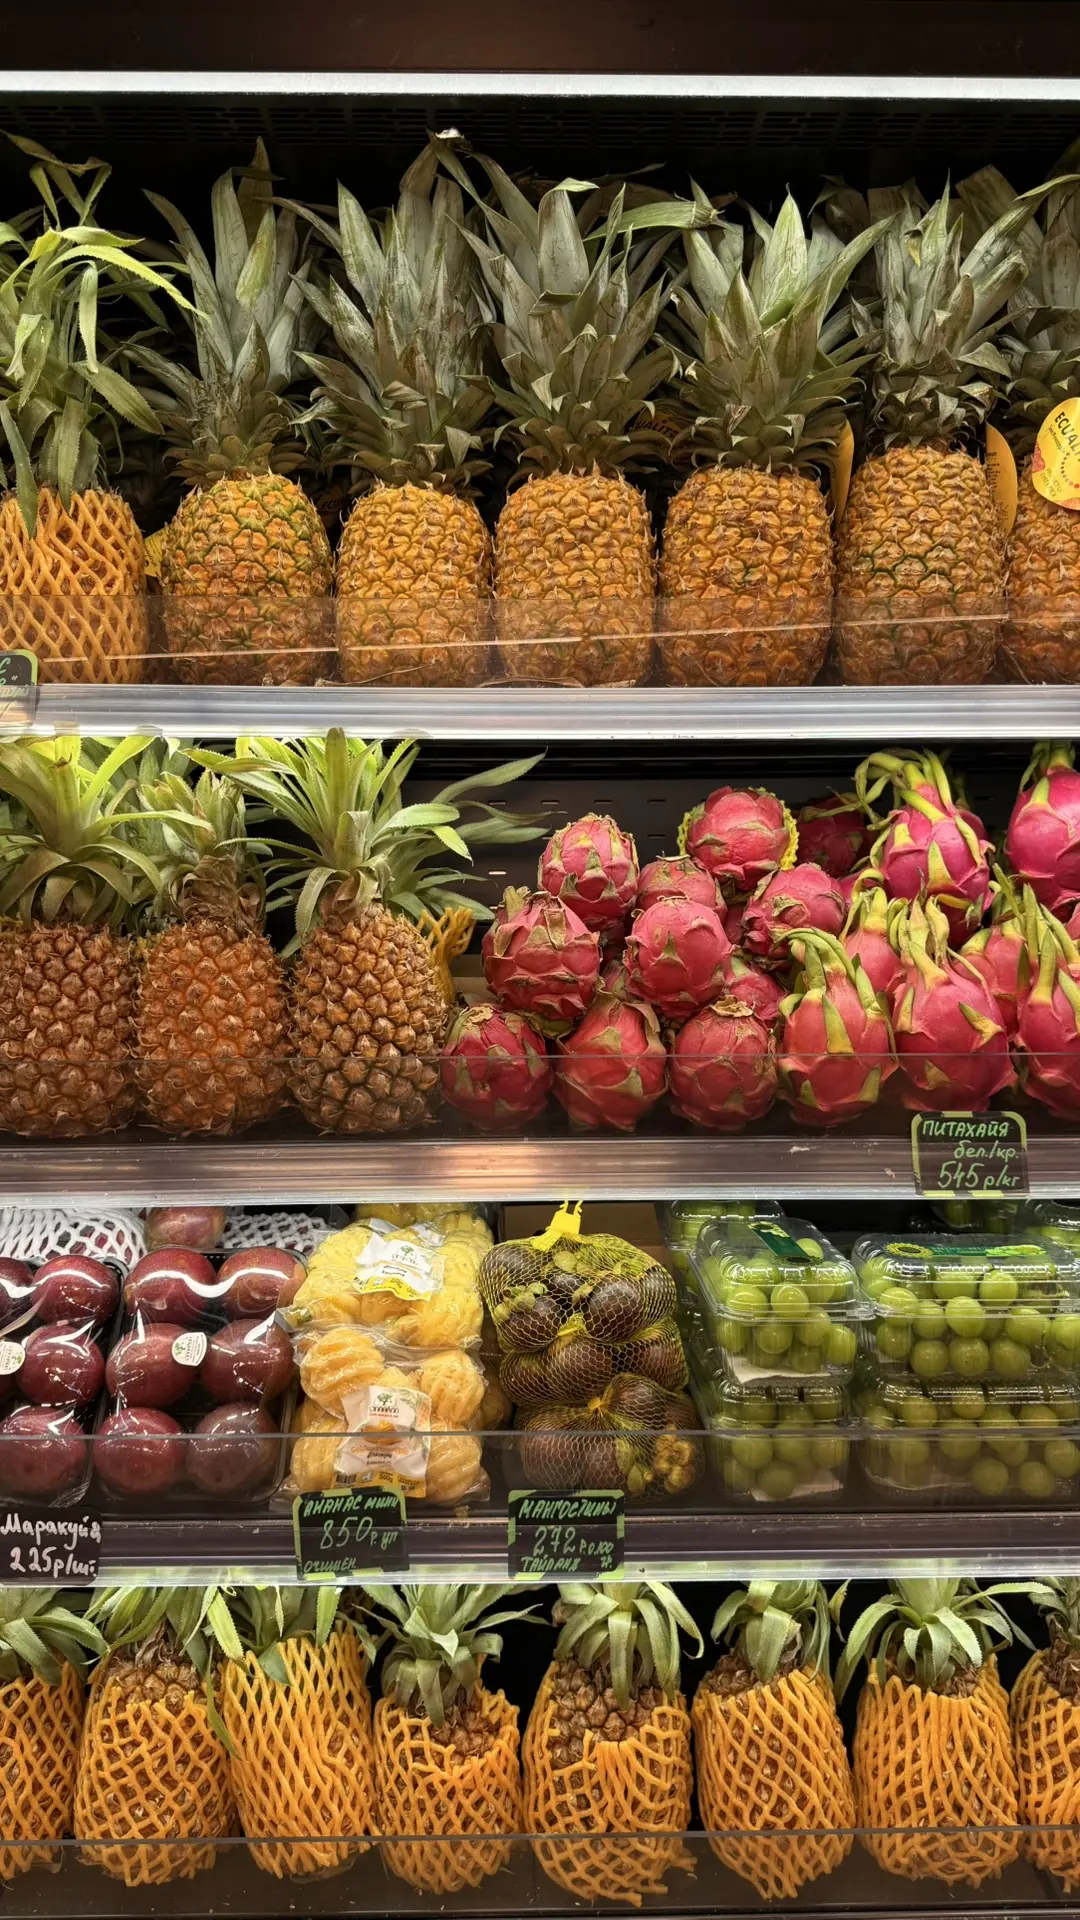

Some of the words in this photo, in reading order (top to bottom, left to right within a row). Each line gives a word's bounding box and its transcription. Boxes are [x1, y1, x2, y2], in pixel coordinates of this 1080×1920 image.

[922, 1120, 1010, 1138] ПИТАХАЙЯ
[937, 1161, 985, 1188] 545
[303, 1495, 363, 1517] АНАНАС
[518, 1499, 617, 1520] МАНГОСТИНЫ
[0, 1512, 102, 1550] Маракуйя
[320, 1516, 373, 1549] 850
[533, 1525, 576, 1557] 272
